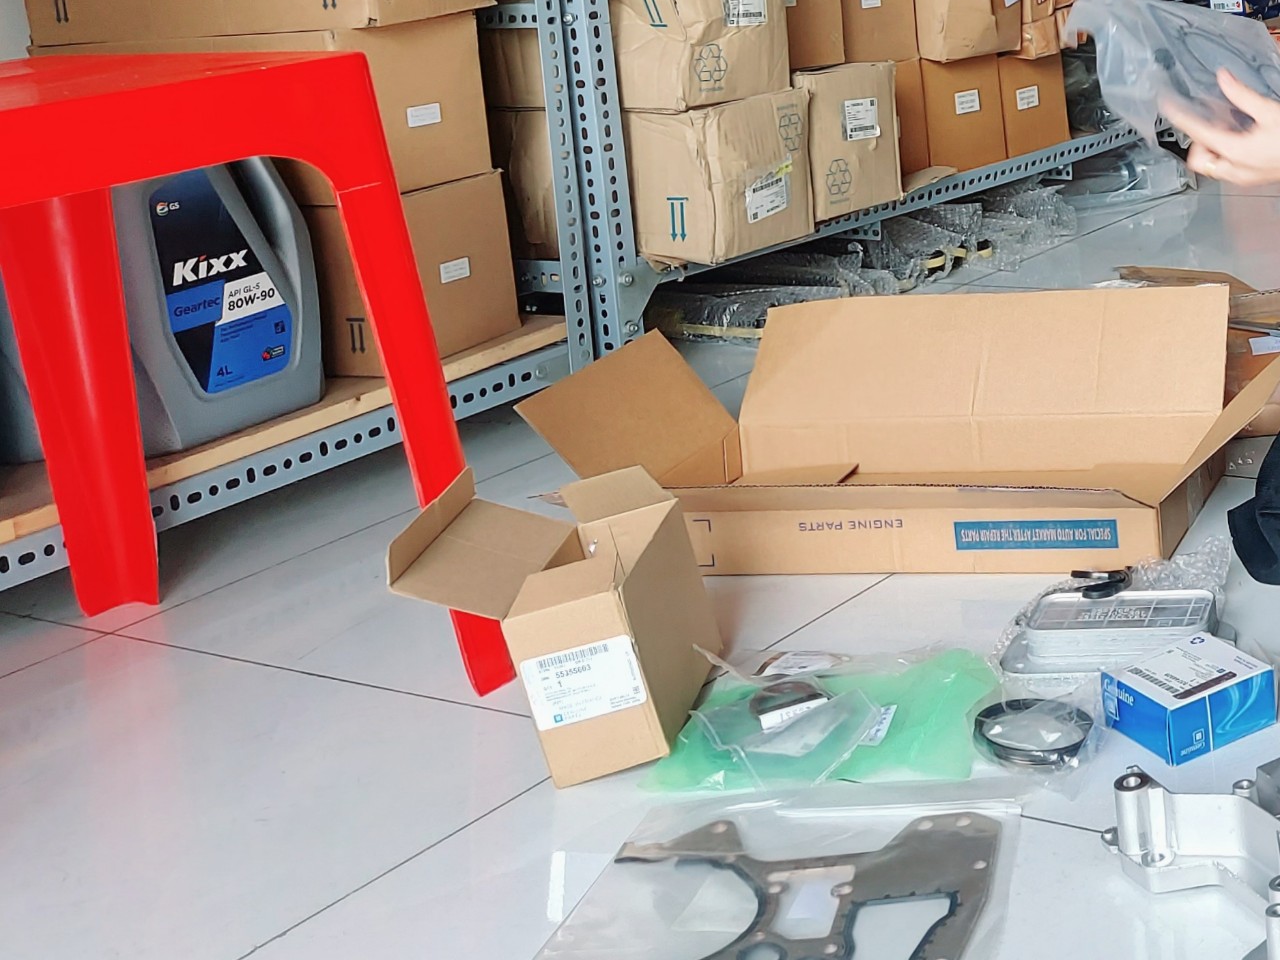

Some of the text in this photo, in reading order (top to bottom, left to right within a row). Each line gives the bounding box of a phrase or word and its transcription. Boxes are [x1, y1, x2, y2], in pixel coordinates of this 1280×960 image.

[169, 202, 180, 211] GS
[172, 248, 248, 287] Kixx
[228, 282, 261, 299] API GL-5
[173, 295, 221, 318] Geartec
[228, 287, 276, 312] 80W-90
[217, 365, 233, 377] 4L
[798, 518, 903, 532] ENGINE PARTS
[960, 527, 1112, 542] SPECIAL FOR AUTO MARKET AFTER THE REPAIR PARTS
